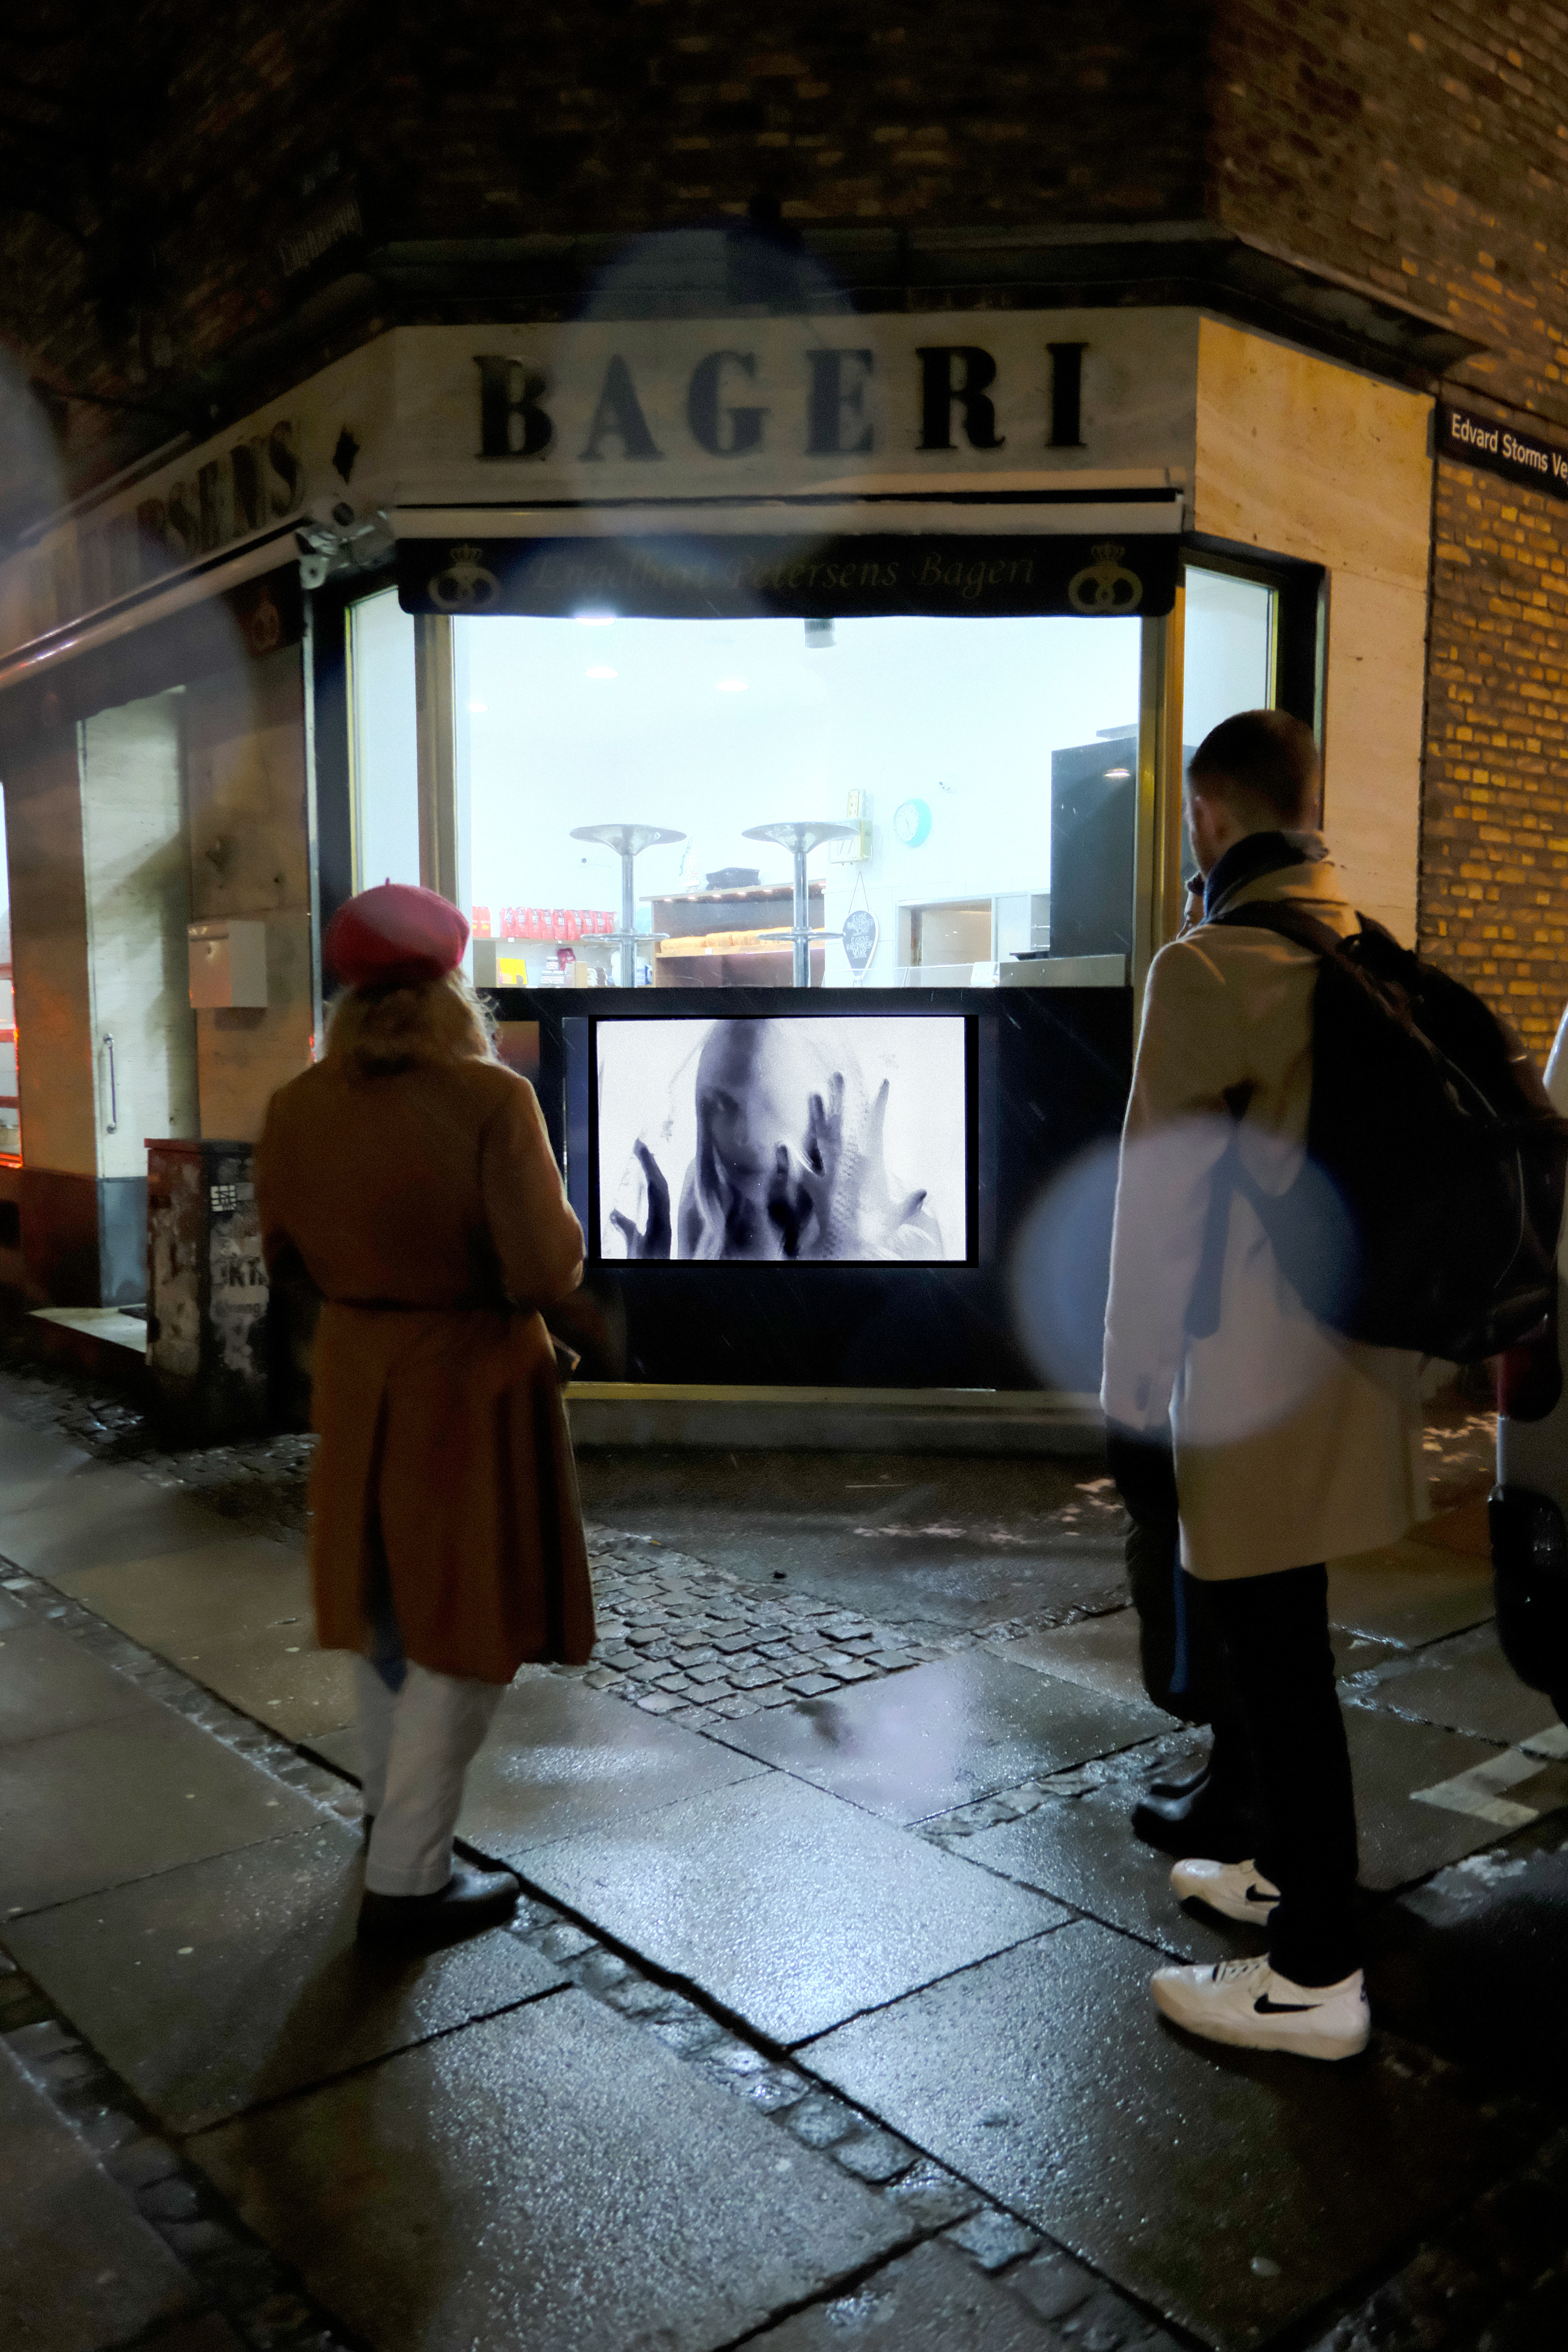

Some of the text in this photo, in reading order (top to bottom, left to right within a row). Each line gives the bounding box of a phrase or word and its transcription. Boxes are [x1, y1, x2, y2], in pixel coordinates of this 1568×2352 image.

[473, 342, 1089, 461] BAGERI
[1452, 413, 1568, 485] Edvard Storms Ve
[726, 555, 900, 590] Petersens
[910, 550, 1037, 600] Bageri
[853, 927, 862, 935] 30
